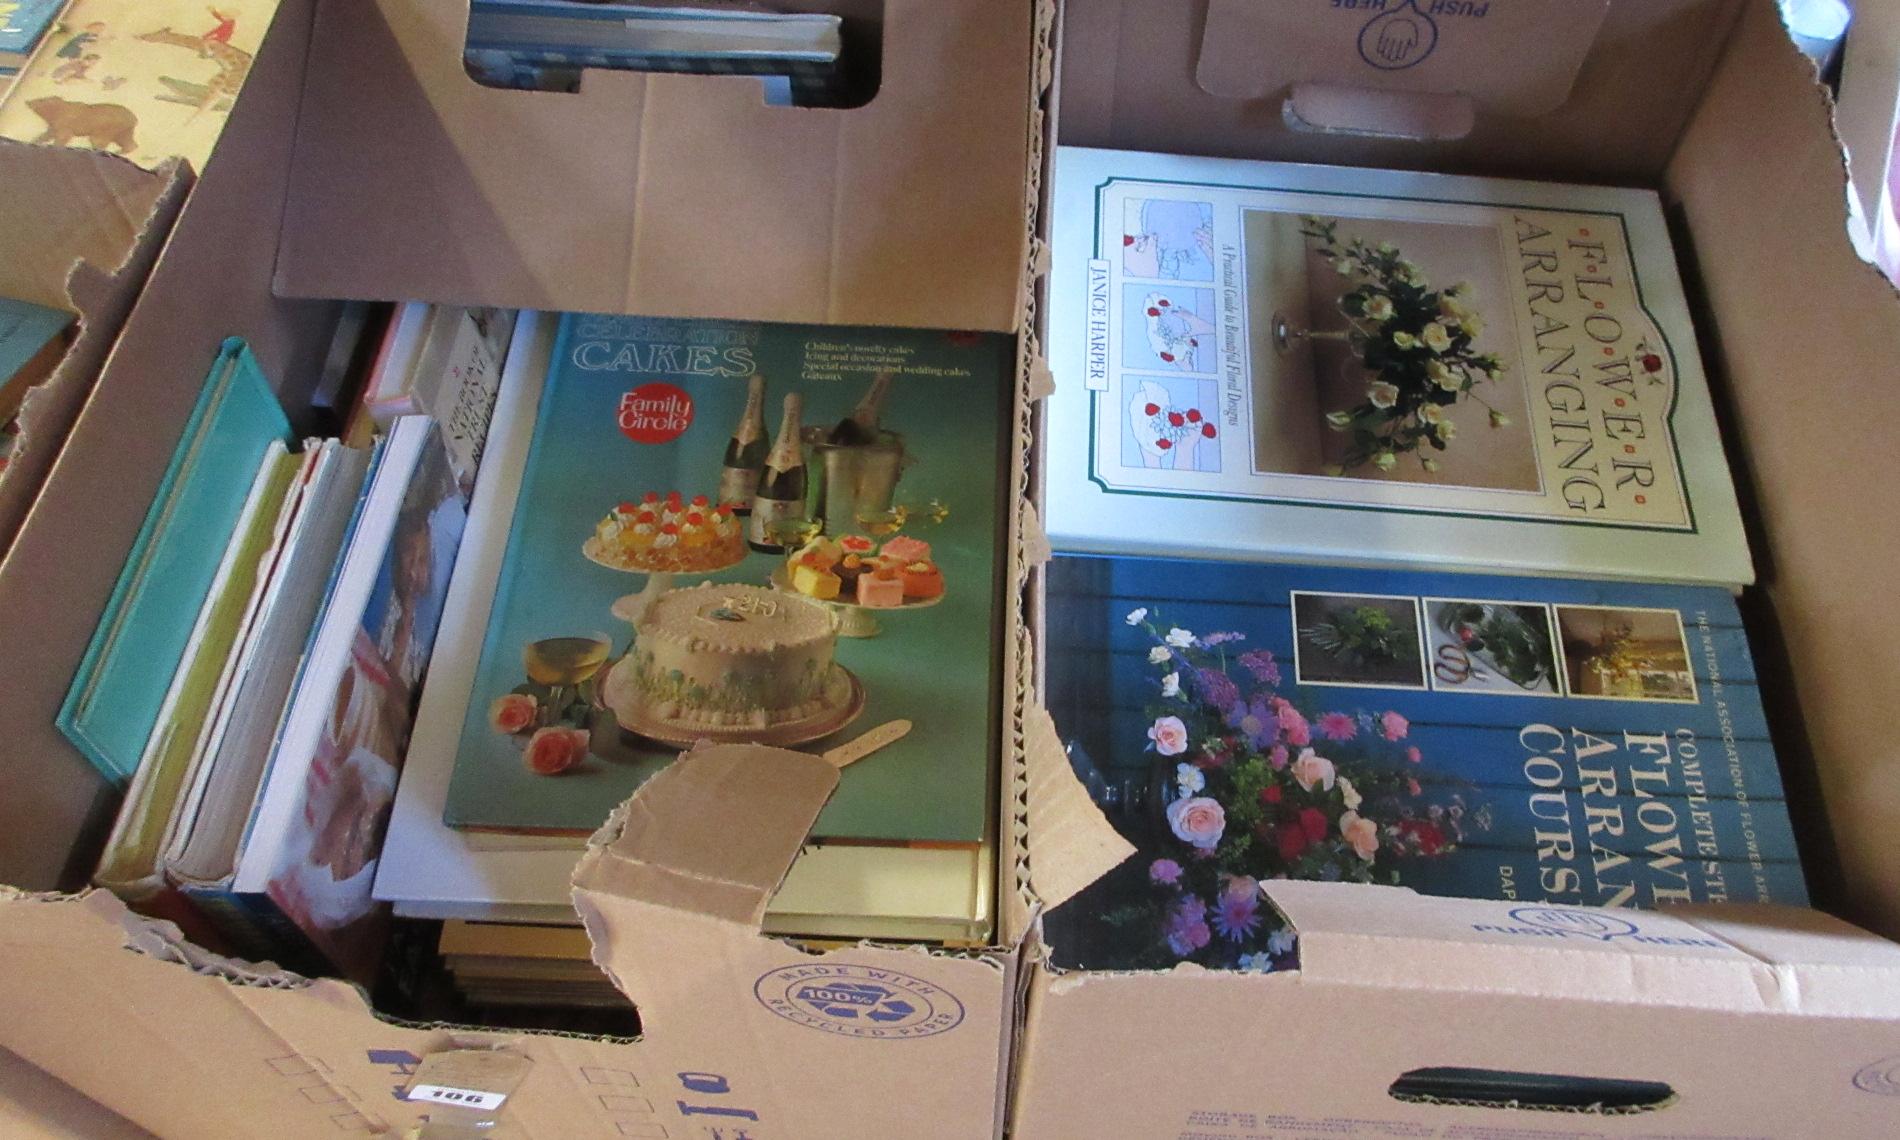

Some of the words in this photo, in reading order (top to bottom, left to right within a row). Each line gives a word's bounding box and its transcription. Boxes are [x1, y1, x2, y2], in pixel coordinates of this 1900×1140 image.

[1431, 1, 1489, 17] PUSH
[1090, 267, 1105, 316] JANICE
[573, 341, 757, 377] CAKES
[1089, 320, 1105, 379] HARPER
[1514, 215, 1606, 513] ARRANGING
[618, 411, 688, 431] Circle
[620, 392, 691, 418] Family
[1704, 635, 1722, 697] NATIONAL
[1716, 701, 1743, 788] ASSOCIATION
[1675, 727, 1718, 857] COMPLETE
[1736, 790, 1749, 807] OF
[1519, 723, 1583, 906] COURS
[1741, 811, 1763, 871] FLOWER
[778, 967, 849, 981] MADE
[868, 970, 935, 995] WITH
[804, 988, 874, 1005] 100%
[770, 998, 885, 1036] RECYCLED
[901, 1012, 954, 1035] PAPER
[433, 1090, 484, 1103] 106
